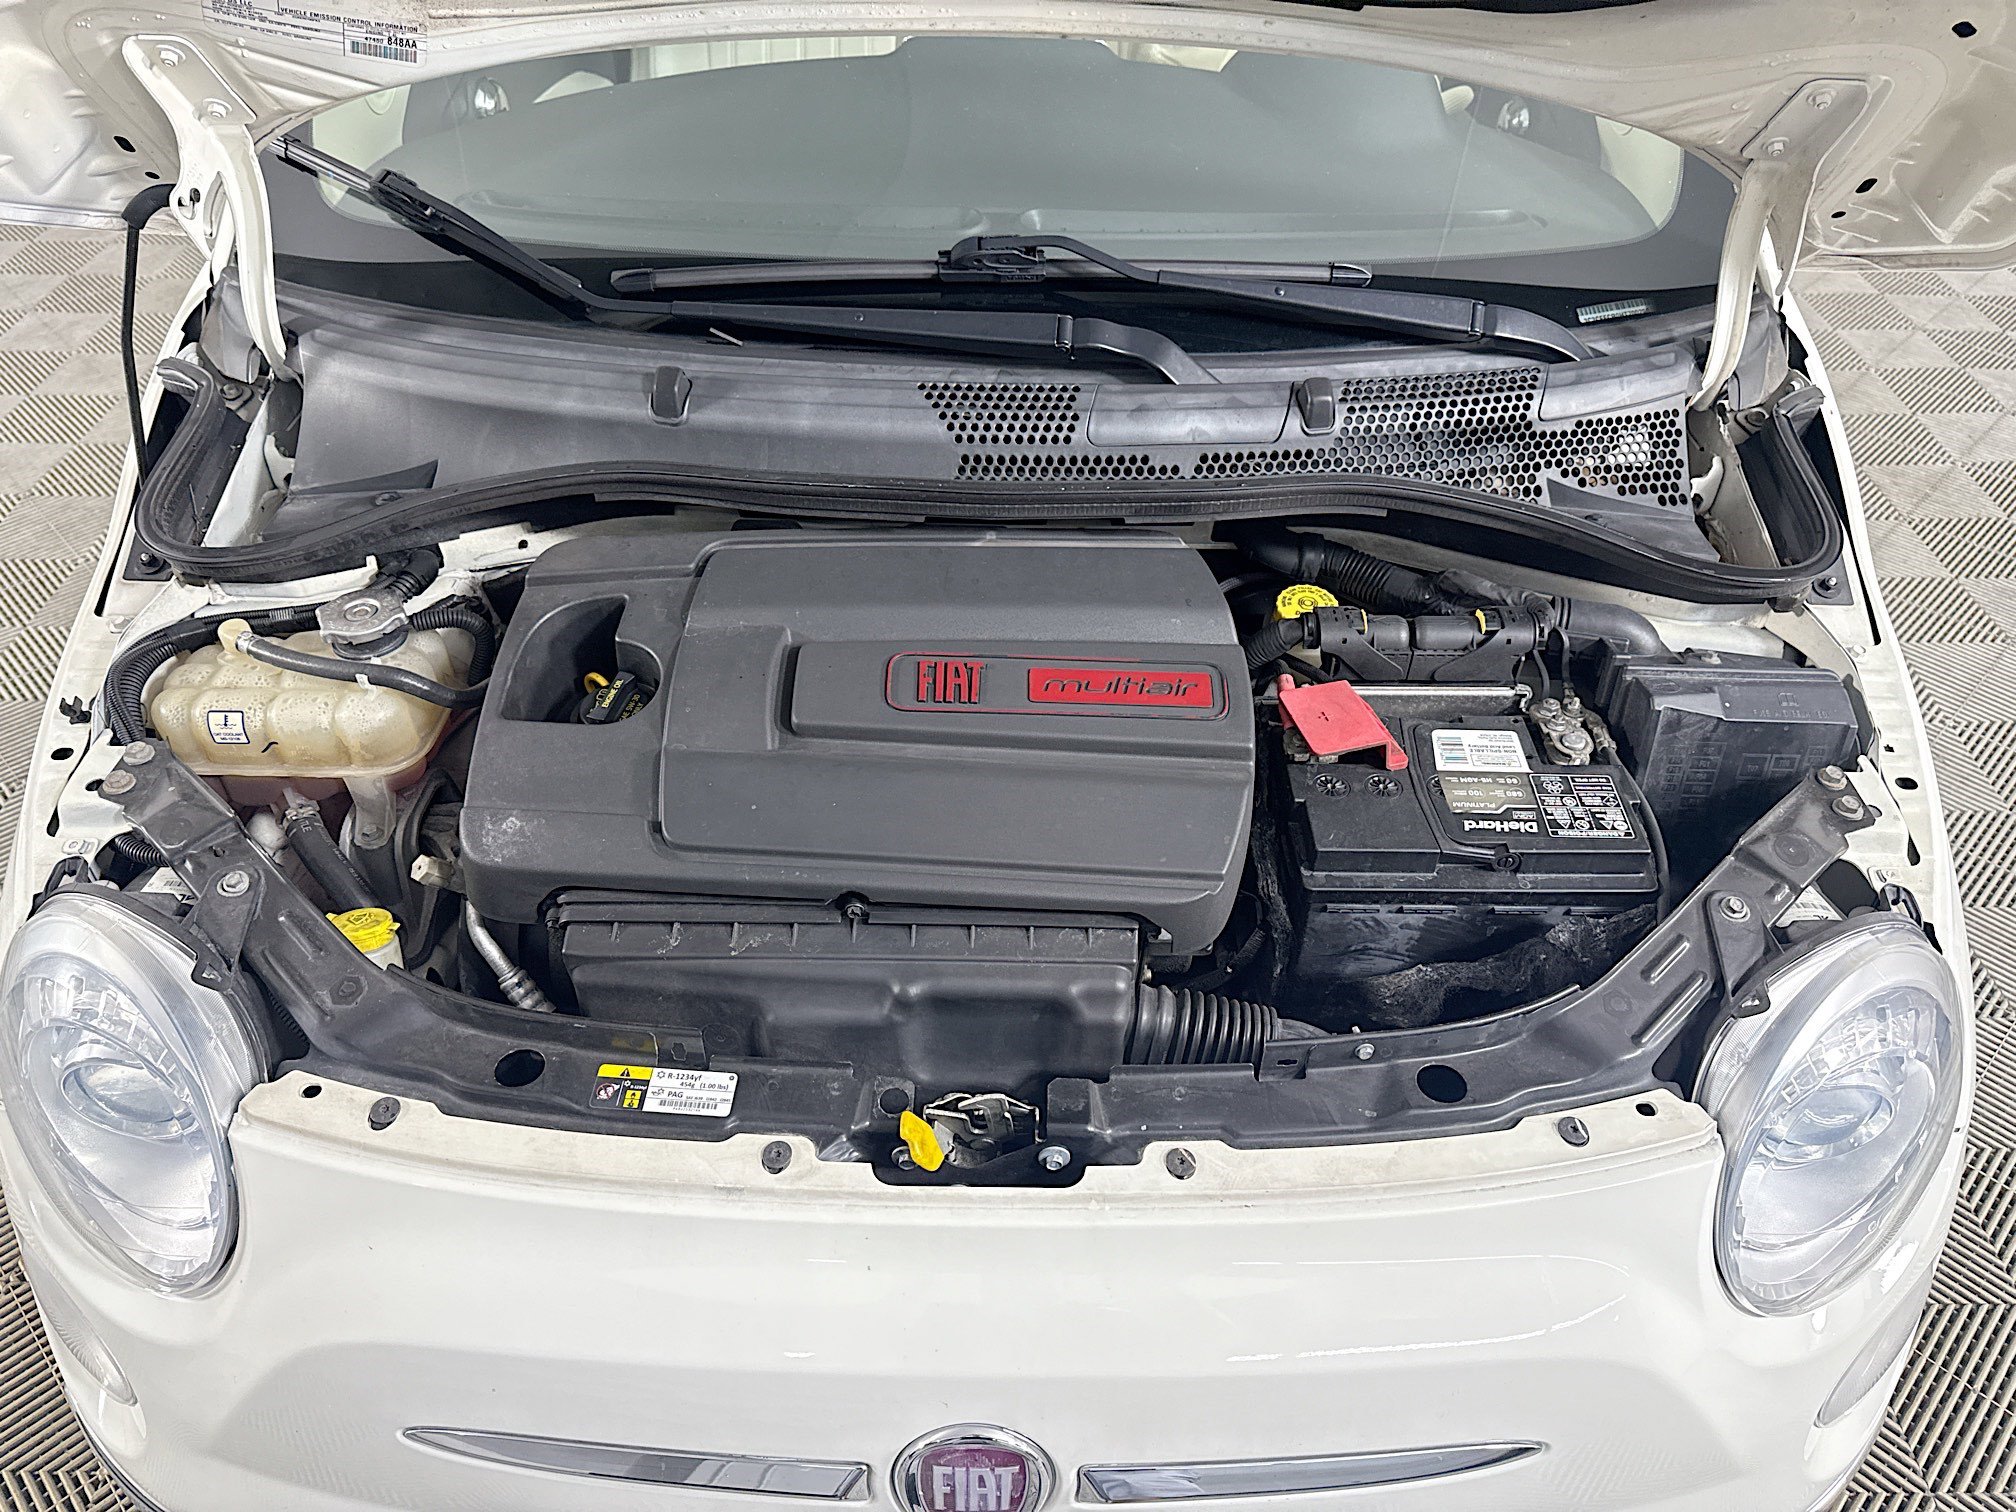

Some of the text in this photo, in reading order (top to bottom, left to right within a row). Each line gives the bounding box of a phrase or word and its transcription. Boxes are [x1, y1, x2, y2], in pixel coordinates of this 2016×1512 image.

[280, 7, 307, 17] VEHICLE
[309, 11, 341, 21] EMISSION
[343, 17, 372, 27] CONTROL
[374, 21, 418, 33] INFORMATION
[387, 36, 418, 49] 848AA
[917, 660, 985, 704] FIAT
[1042, 675, 1198, 698] multiair
[601, 679, 625, 708] ENGINE OIL
[1505, 789, 1523, 797] 680
[1463, 820, 1539, 833] DieHard
[667, 1072, 703, 1082] R-1234yf
[717, 1083, 729, 1091] lbs)
[667, 1091, 684, 1099] PAG
[932, 1465, 1020, 1511] FIAT
